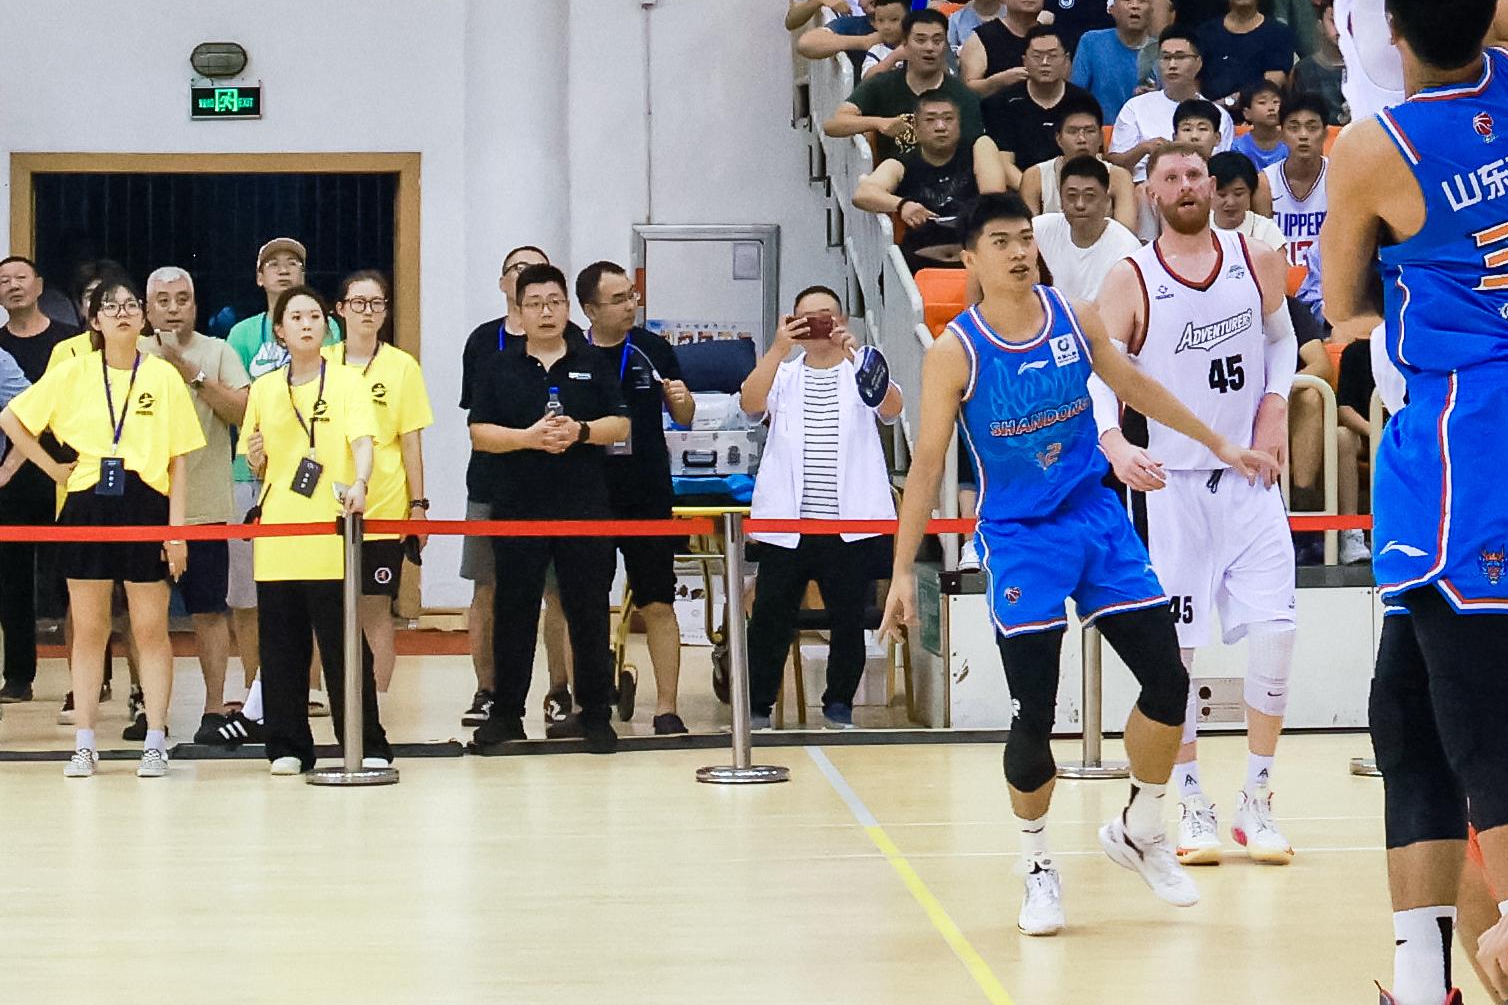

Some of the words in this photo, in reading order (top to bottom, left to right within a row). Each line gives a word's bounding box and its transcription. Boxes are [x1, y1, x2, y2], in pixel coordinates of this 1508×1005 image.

[1272, 211, 1328, 237] LIPPER
[1208, 353, 1246, 394] 45
[1168, 595, 1194, 625] 45
